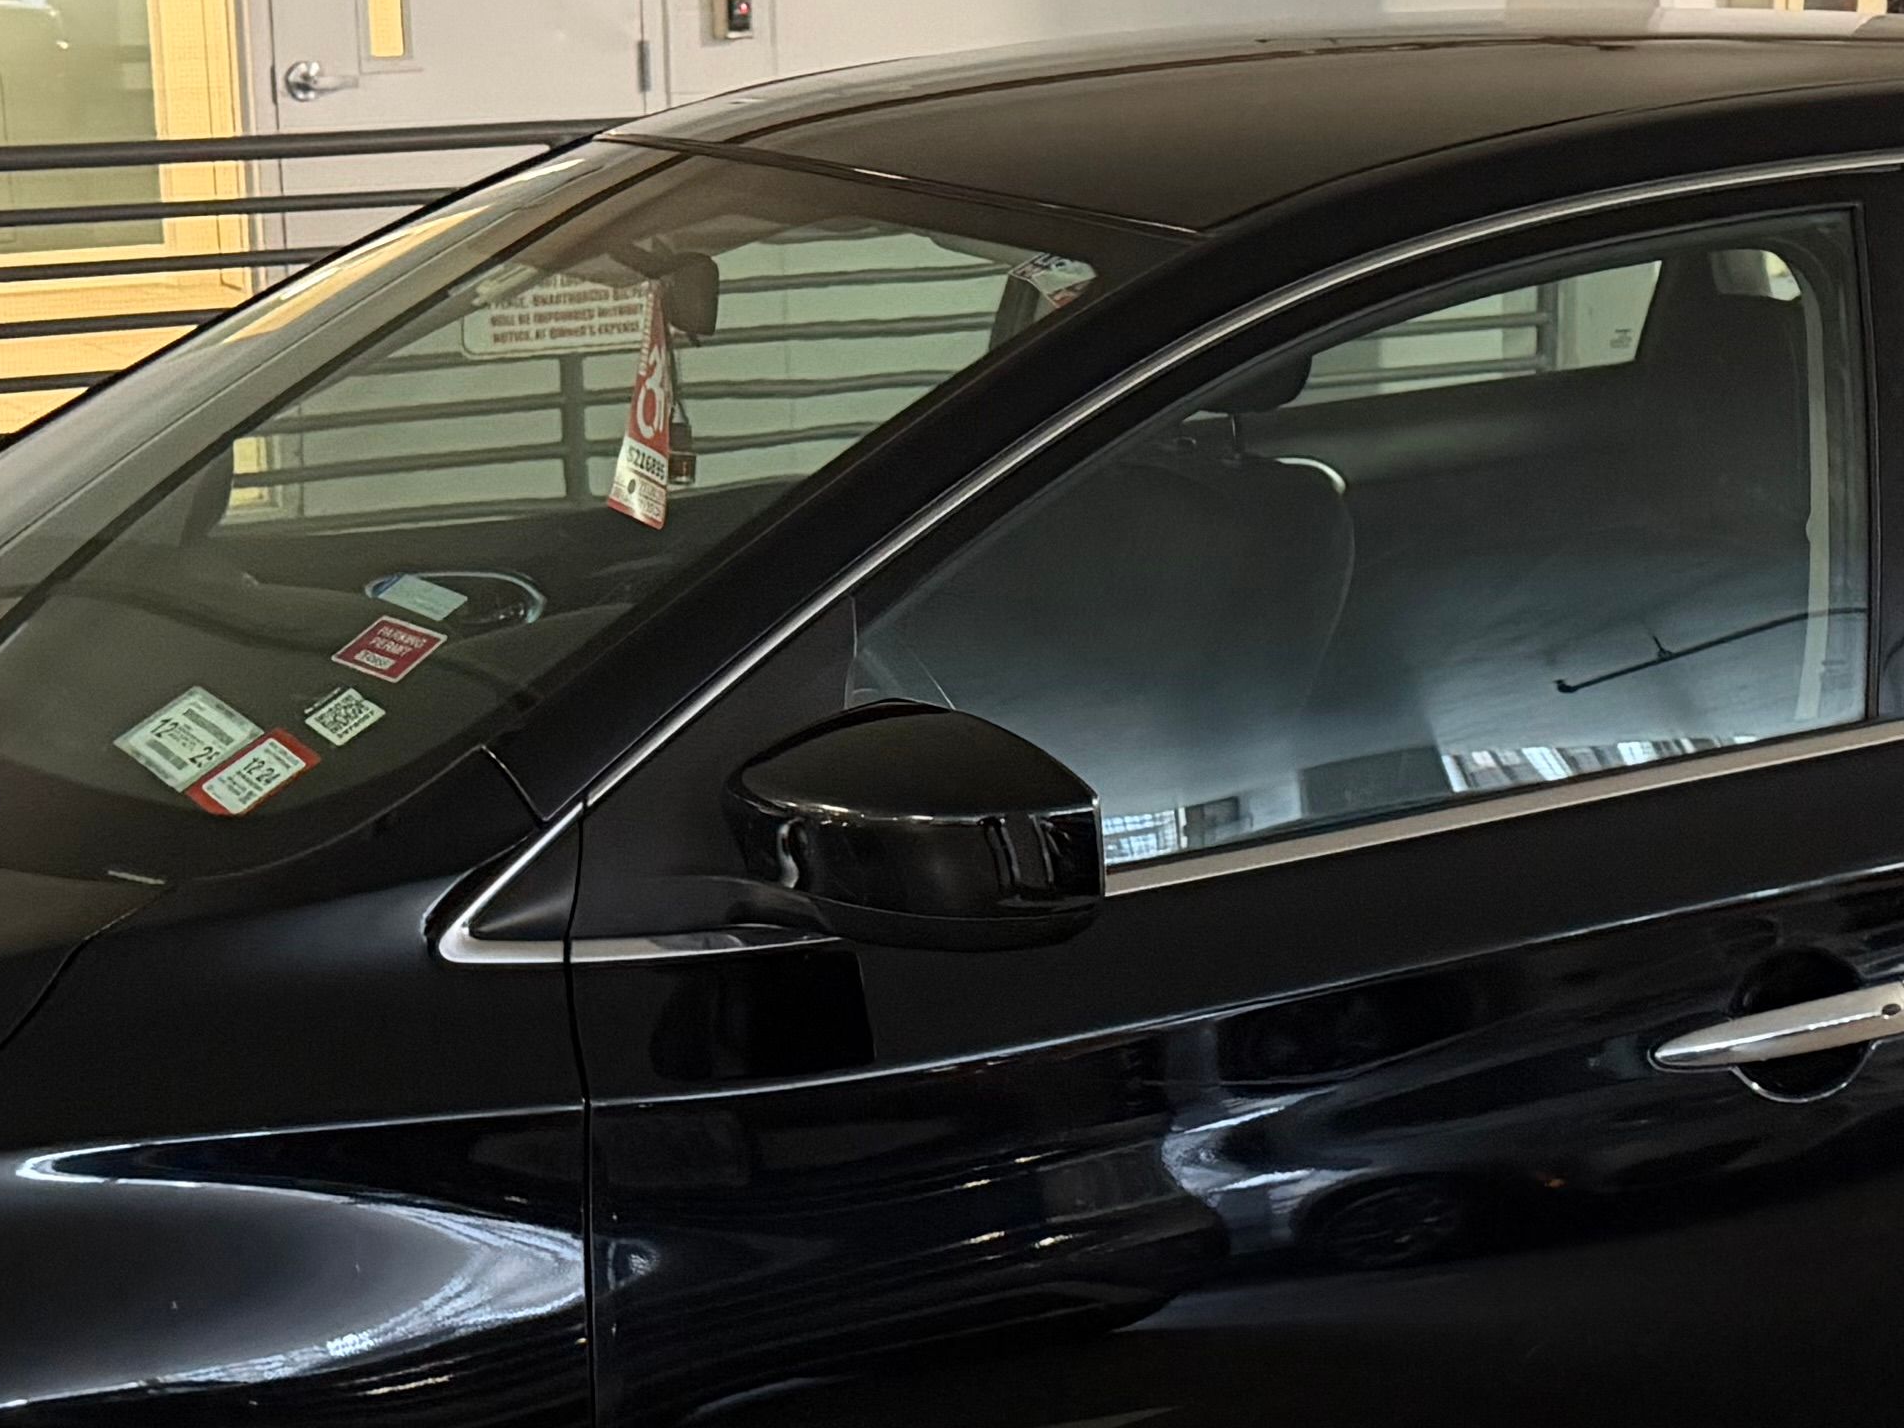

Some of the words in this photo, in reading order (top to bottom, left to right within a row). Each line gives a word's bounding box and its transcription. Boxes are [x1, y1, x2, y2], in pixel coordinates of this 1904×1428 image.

[369, 636, 415, 658] PERMIT
[376, 625, 428, 650] PARKING
[150, 718, 179, 738] 12
